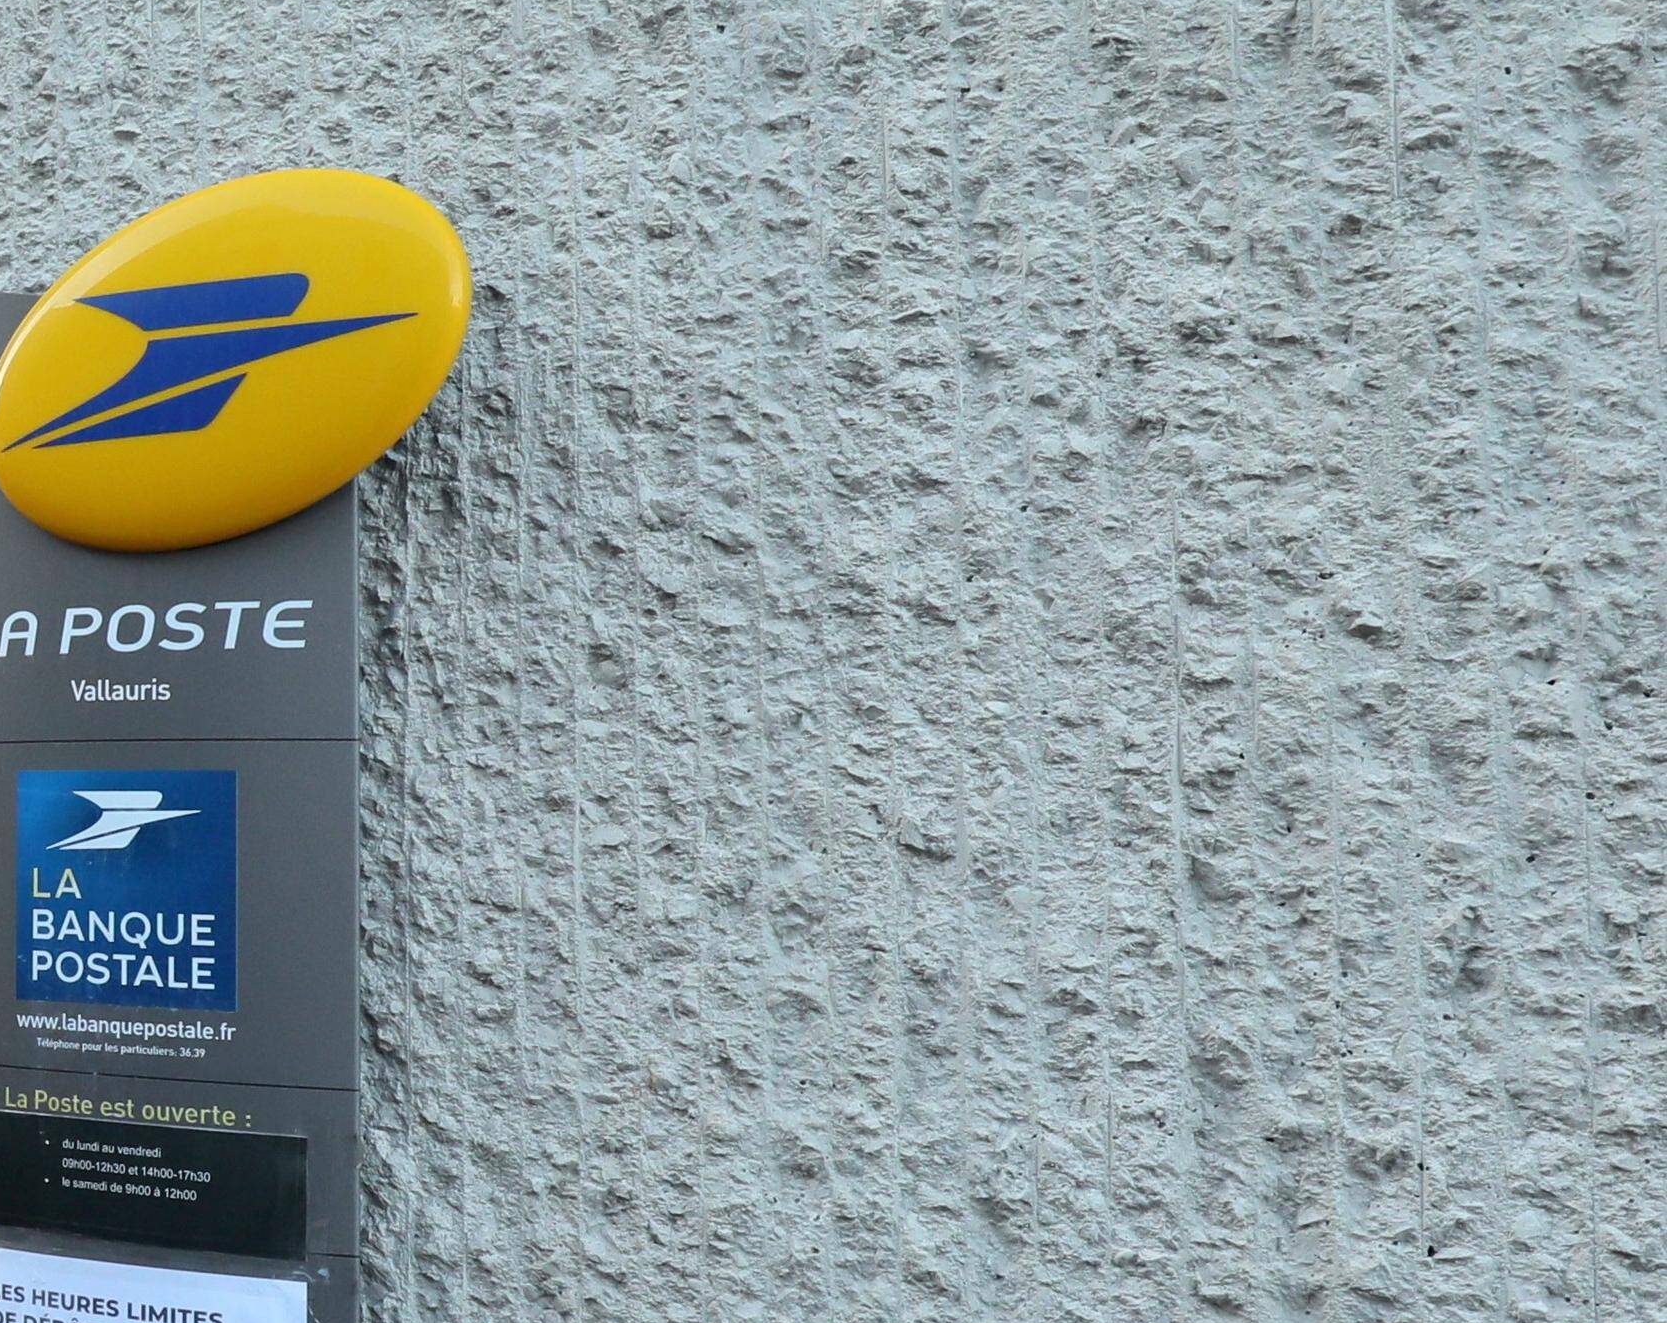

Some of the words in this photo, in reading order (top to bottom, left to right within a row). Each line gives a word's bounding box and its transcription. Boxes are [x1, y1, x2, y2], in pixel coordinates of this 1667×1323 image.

[59, 599, 313, 655] POSTE
[71, 678, 171, 702] Vallauris
[32, 867, 82, 899] LA
[32, 908, 215, 949] BANQUE
[31, 950, 215, 990] POSTALE
[16, 1013, 236, 1040] www.labanquepostale.fr
[36, 1037, 80, 1051] Téléphone
[82, 1042, 102, 1053] pour
[104, 1043, 119, 1053] les
[5, 1086, 28, 1109] La
[34, 1089, 93, 1116] Poste
[100, 1098, 134, 1118] est
[142, 1105, 236, 1127] ouverte
[62, 1138, 74, 1150] du
[76, 1140, 100, 1152] lundi
[102, 1143, 115, 1154] au
[117, 1143, 162, 1158] vendredi
[62, 1157, 126, 1175] 09h00-12h30
[128, 1166, 139, 1176] et
[142, 1166, 211, 1183] 14h00-17h30
[62, 1177, 70, 1188] le
[73, 1178, 107, 1192] samedi
[110, 1183, 123, 1194] de
[125, 1183, 151, 1197] 9h00
[153, 1185, 161, 1198] à
[164, 1188, 197, 1201] 12h00
[31, 1288, 119, 1317] HEURES
